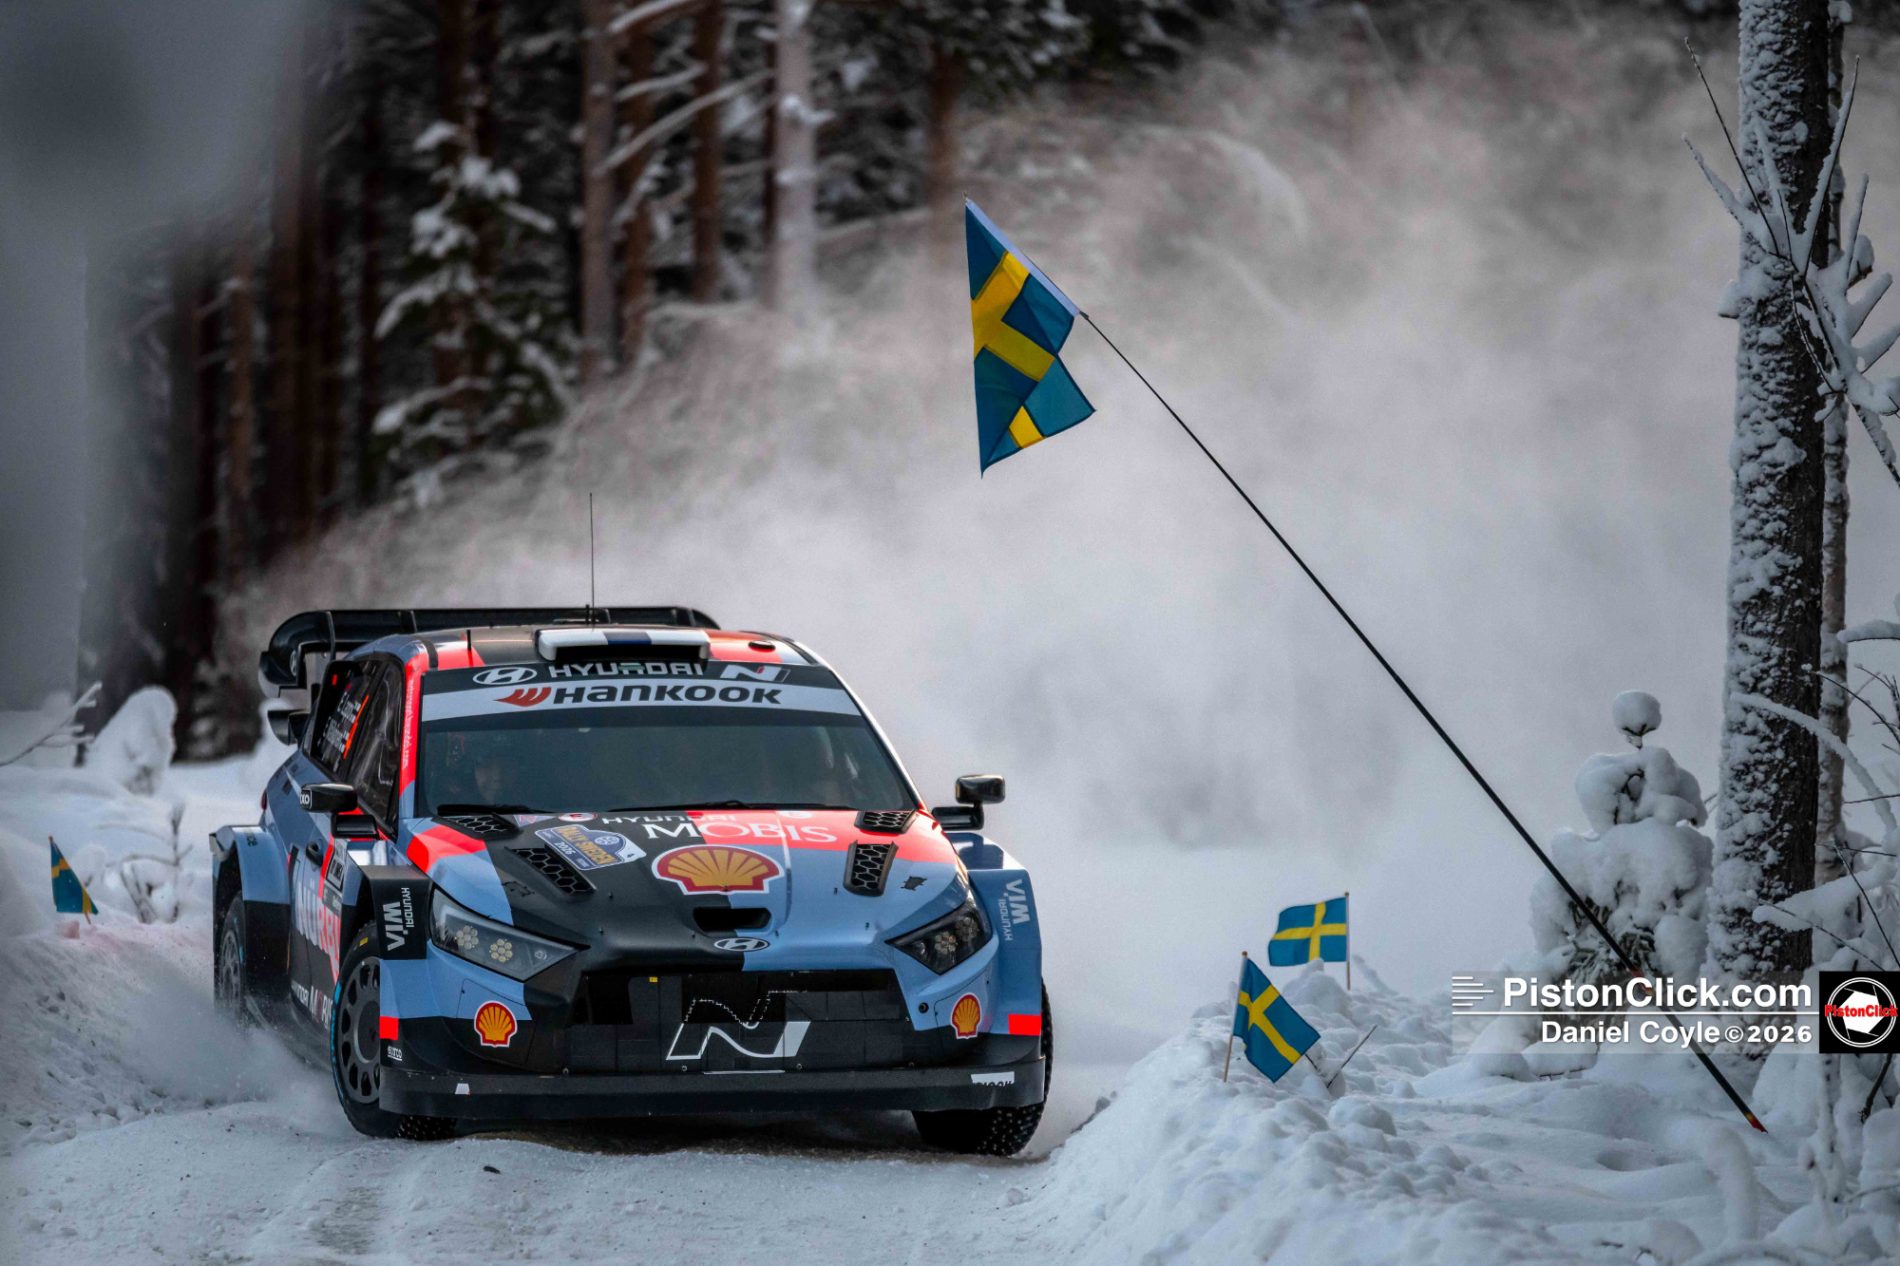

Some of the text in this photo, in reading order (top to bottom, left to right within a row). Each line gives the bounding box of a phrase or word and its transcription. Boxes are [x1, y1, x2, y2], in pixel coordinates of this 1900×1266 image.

[547, 662, 704, 678] HYUNDAI
[642, 822, 837, 843] MOBIS
[401, 887, 415, 929] HYUNDAI
[997, 898, 1014, 941] HYUNDAI
[1006, 878, 1031, 925] WIA
[382, 901, 406, 952] WIA
